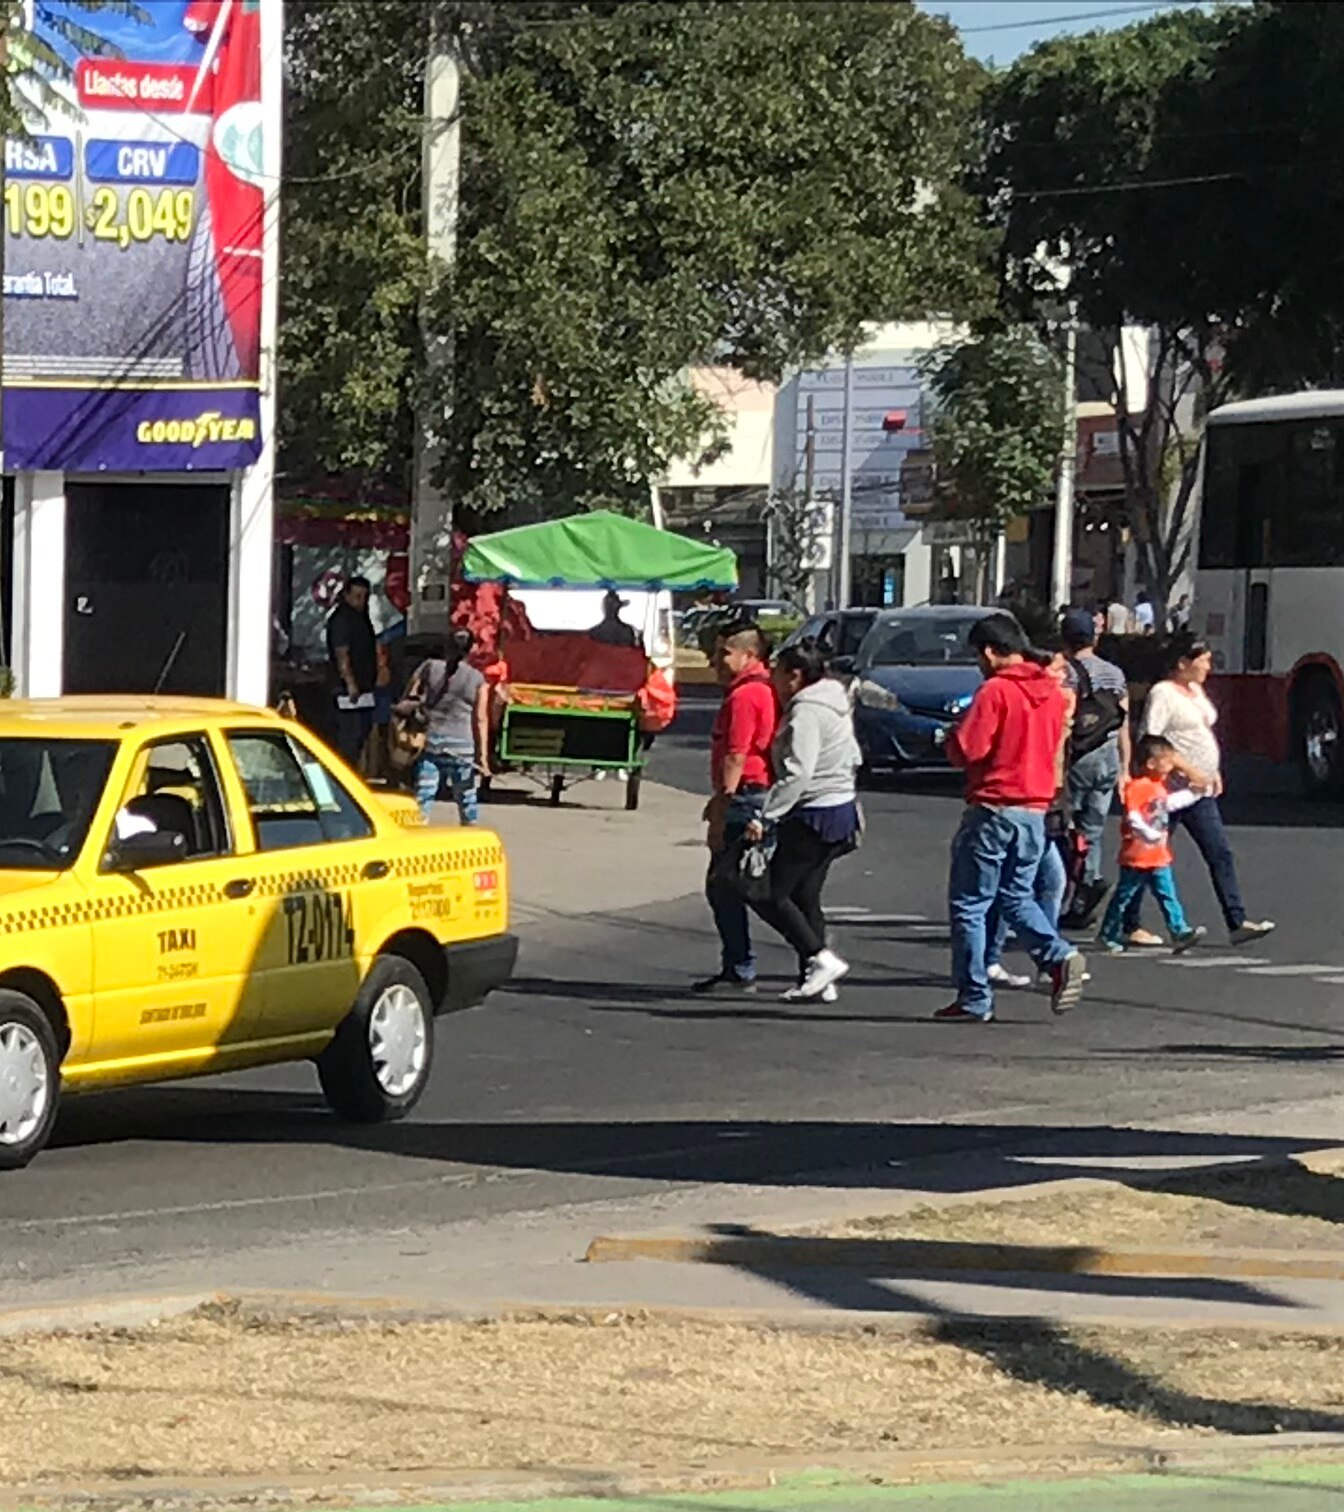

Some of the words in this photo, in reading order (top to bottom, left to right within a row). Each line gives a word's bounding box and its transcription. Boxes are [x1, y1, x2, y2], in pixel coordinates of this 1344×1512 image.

[84, 71, 137, 98] Llantas
[139, 75, 185, 101] desde
[117, 146, 167, 177] CRV
[156, 928, 197, 955] TAXI
